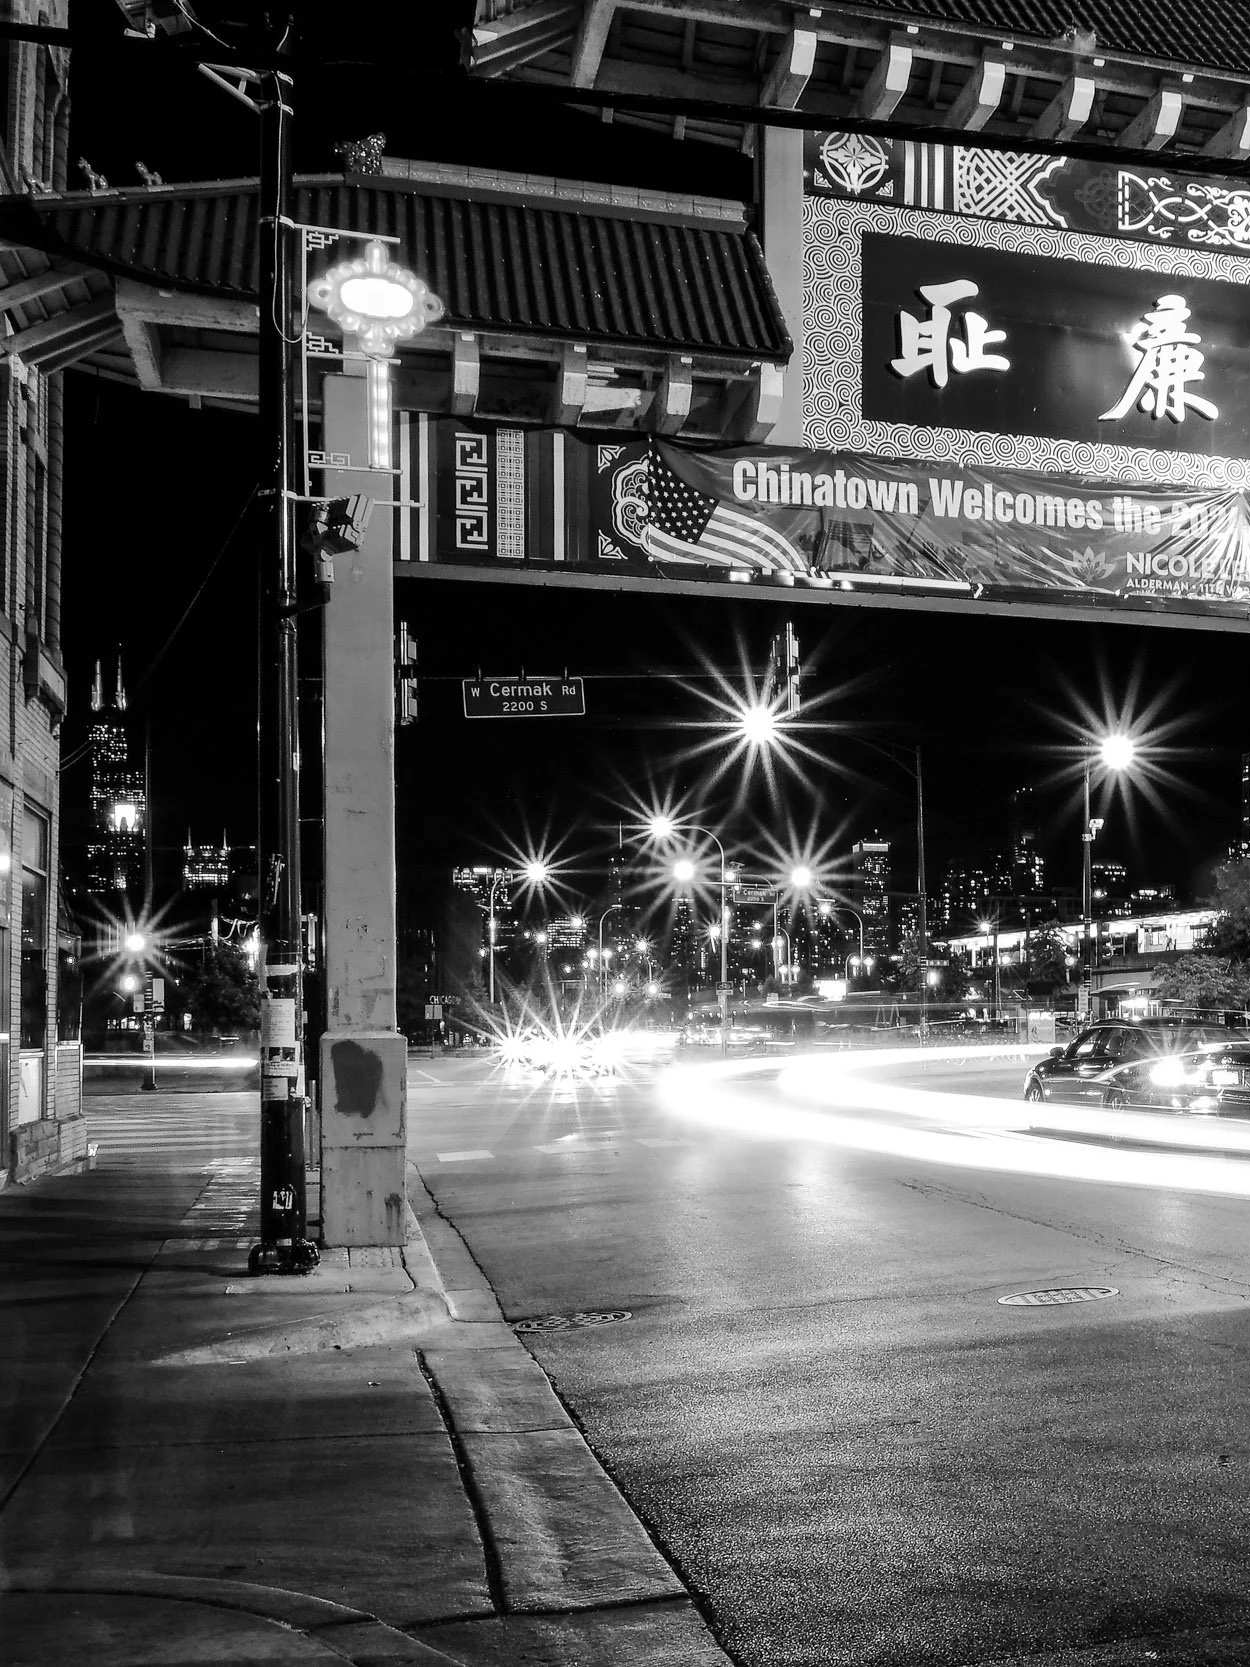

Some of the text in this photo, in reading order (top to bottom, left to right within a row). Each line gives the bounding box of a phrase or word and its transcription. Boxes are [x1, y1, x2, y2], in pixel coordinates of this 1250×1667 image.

[732, 460, 919, 514] Chinatown
[929, 478, 1103, 530] Welcomes
[1112, 496, 1161, 535] the
[1126, 552, 1214, 579] NICOLE
[1126, 578, 1189, 591] ALDERMAN
[471, 682, 575, 697] W Cermak Rd
[503, 701, 548, 712] 2200 S
